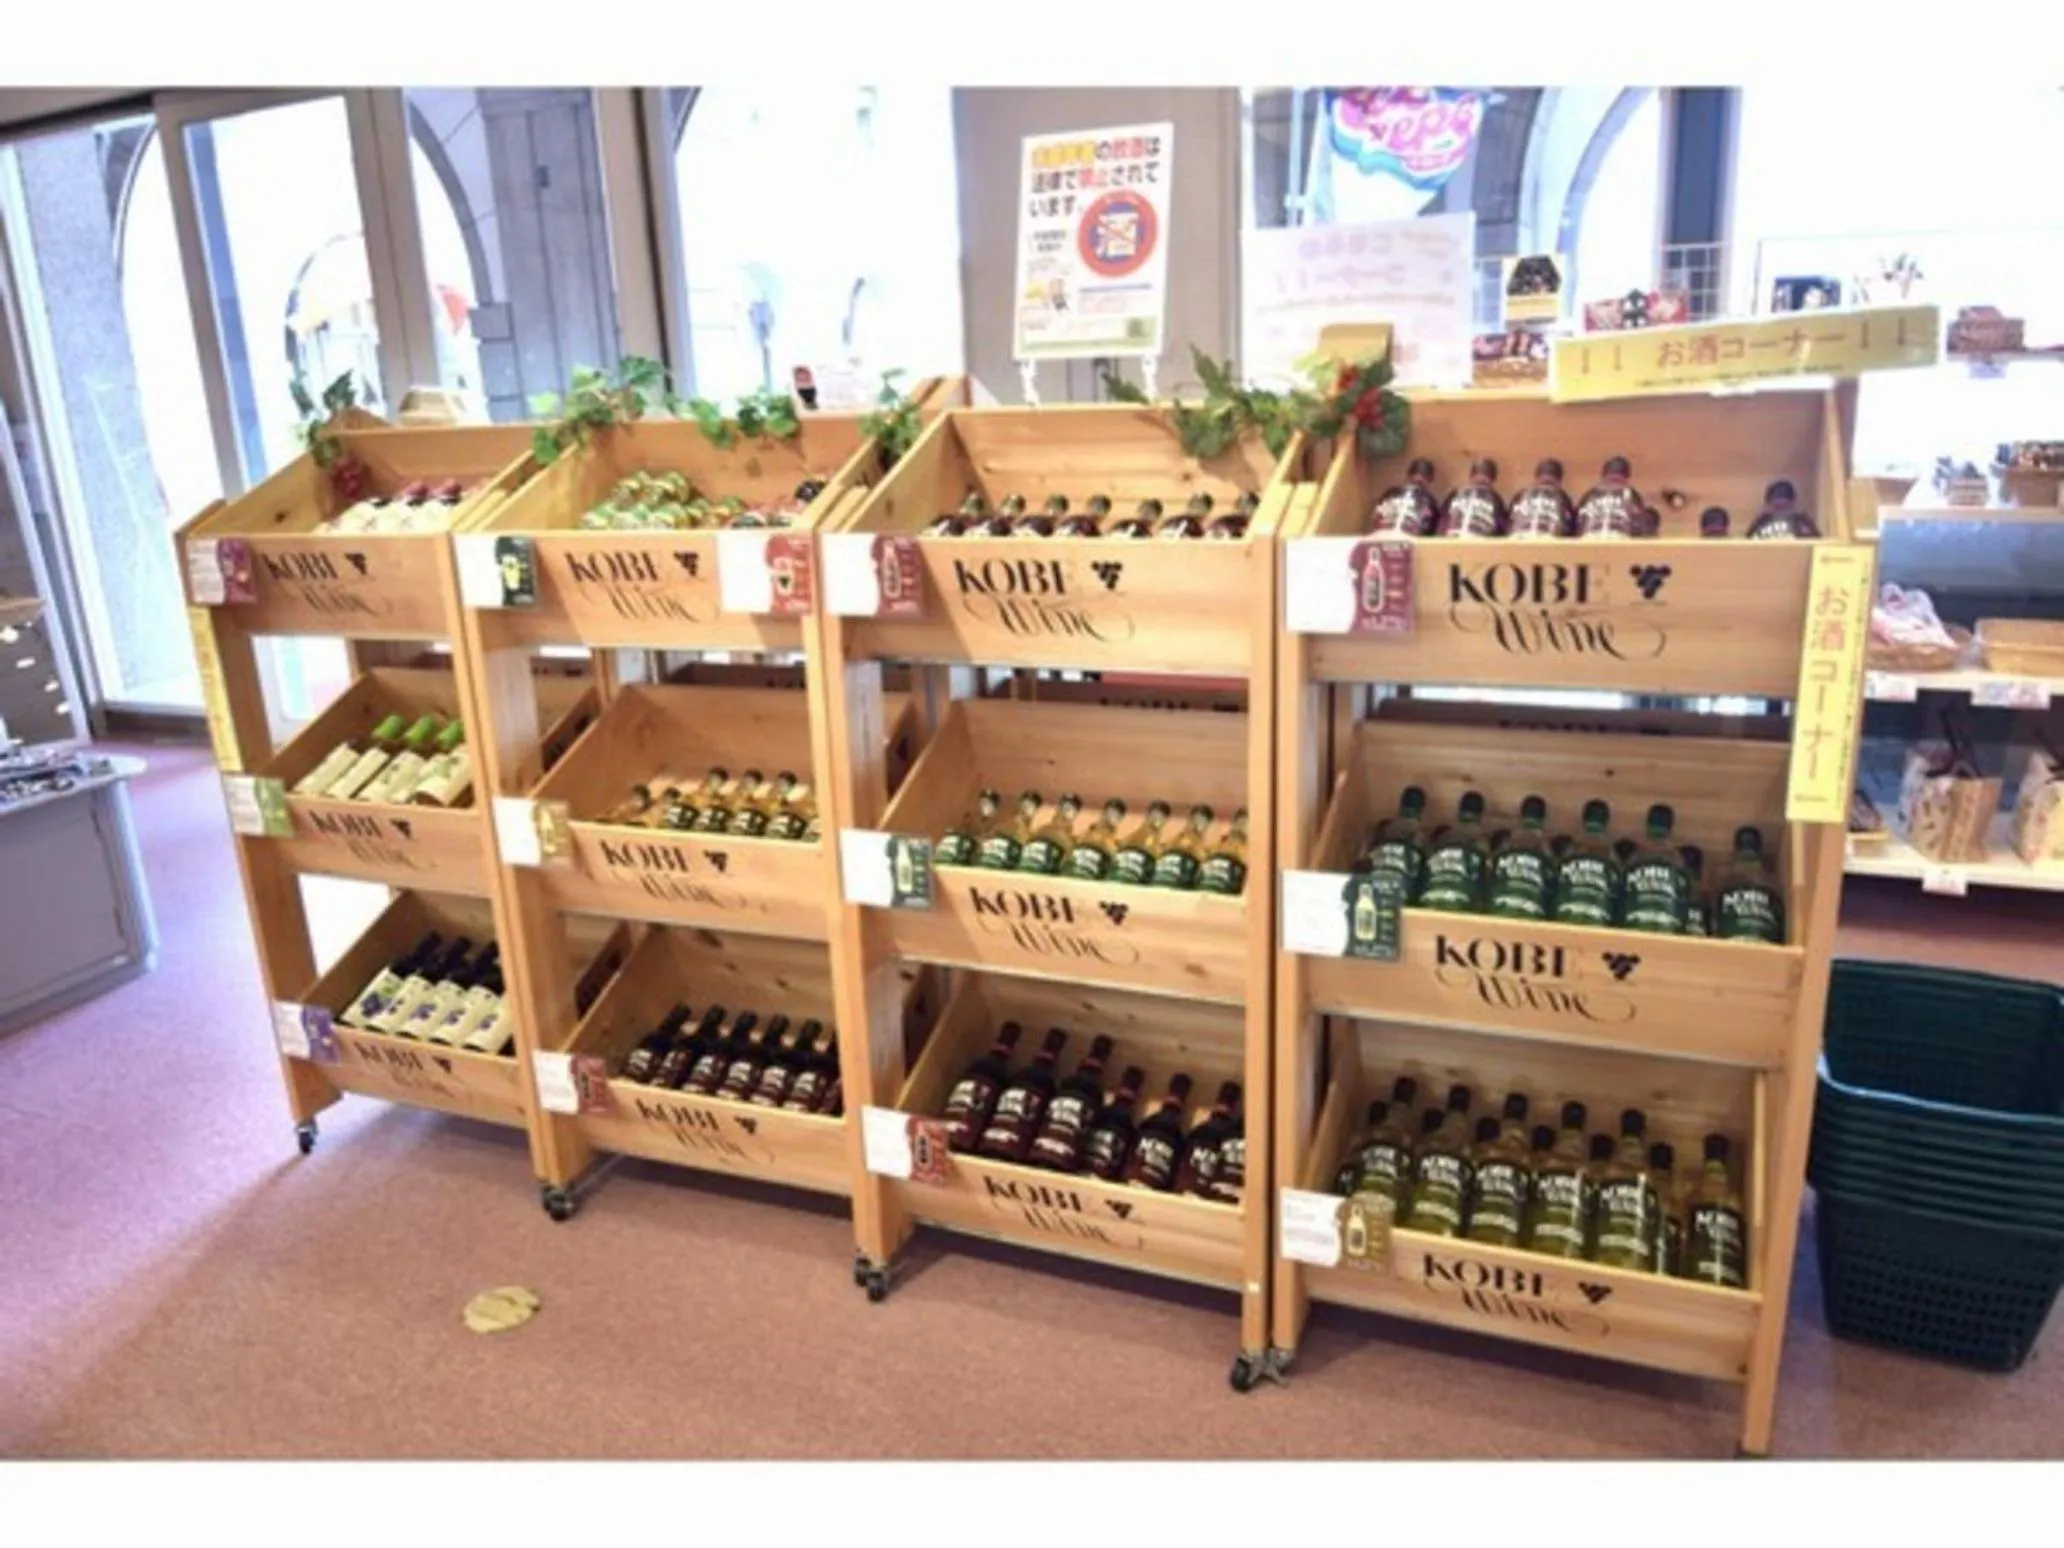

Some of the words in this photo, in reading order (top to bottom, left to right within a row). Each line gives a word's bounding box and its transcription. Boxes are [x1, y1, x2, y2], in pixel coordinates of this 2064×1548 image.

[1656, 326, 1845, 369] お酒コーナー
[1450, 563, 1608, 604] KOBE
[1450, 602, 1668, 661] Wine
[1800, 583, 1850, 780] お酒コーナー
[1436, 934, 1578, 979] KOBE
[1422, 1253, 1556, 1297] KOBE
